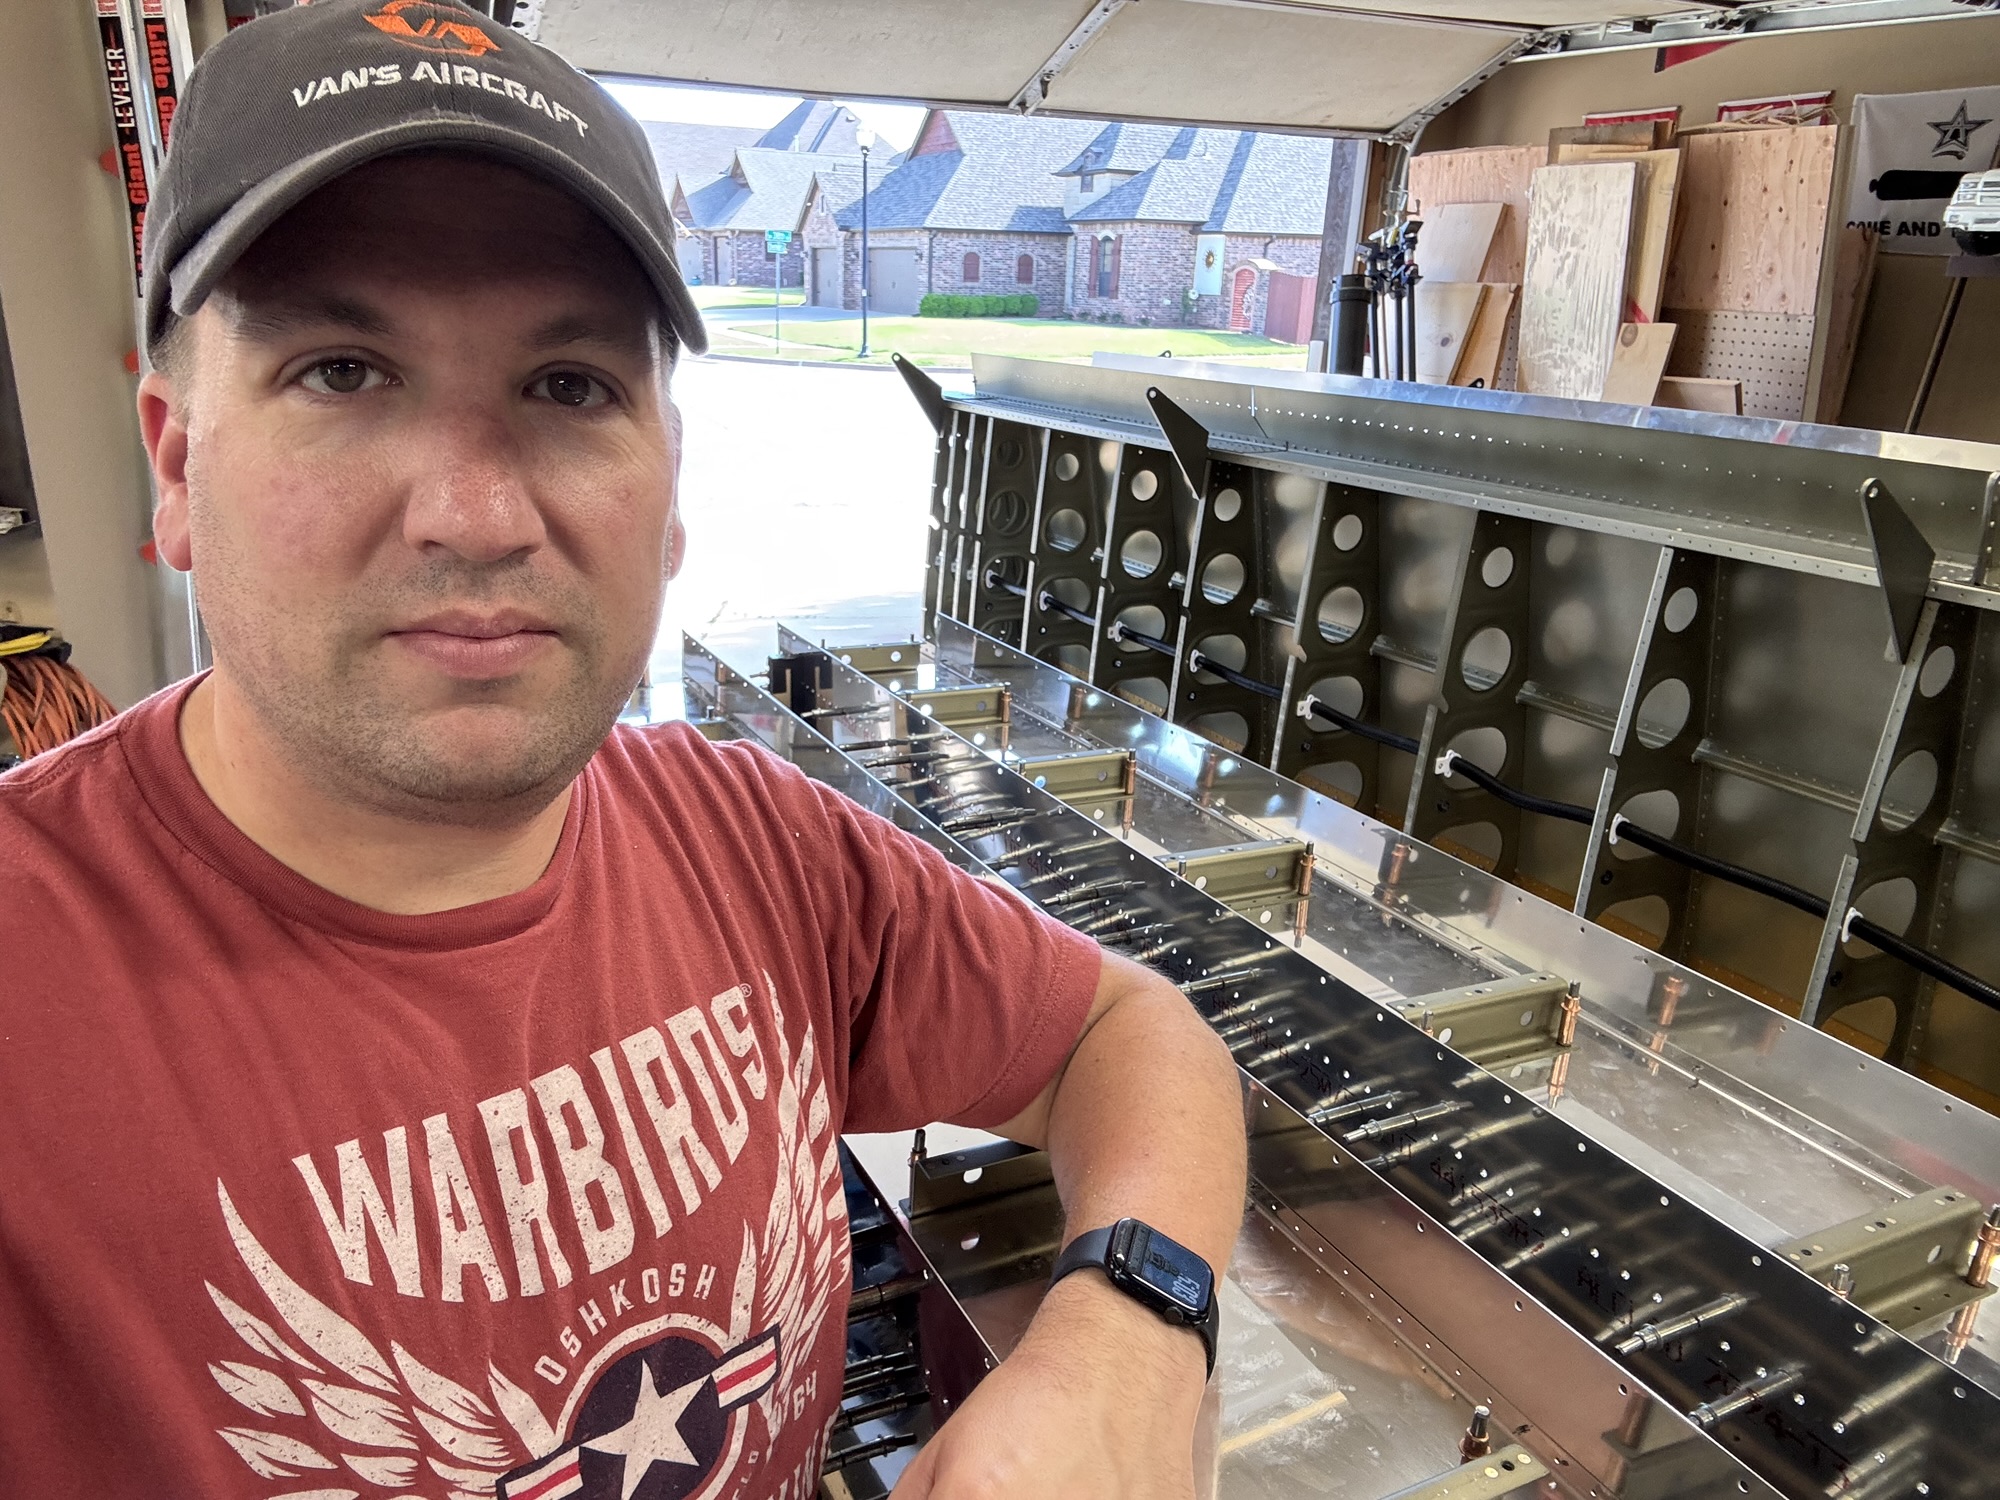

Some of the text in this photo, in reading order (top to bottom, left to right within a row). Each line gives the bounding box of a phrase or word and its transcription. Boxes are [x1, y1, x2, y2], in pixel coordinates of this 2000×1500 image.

[106, 48, 135, 128] LEVELER
[292, 61, 589, 138] VAN'S AIRCRAFT
[123, 143, 149, 205] Giant
[1896, 221, 1941, 237] AND
[291, 985, 768, 1303] WARBIRDS
[534, 1263, 717, 1386] OSHKOSH
[1172, 1272, 1200, 1305] 5:03
